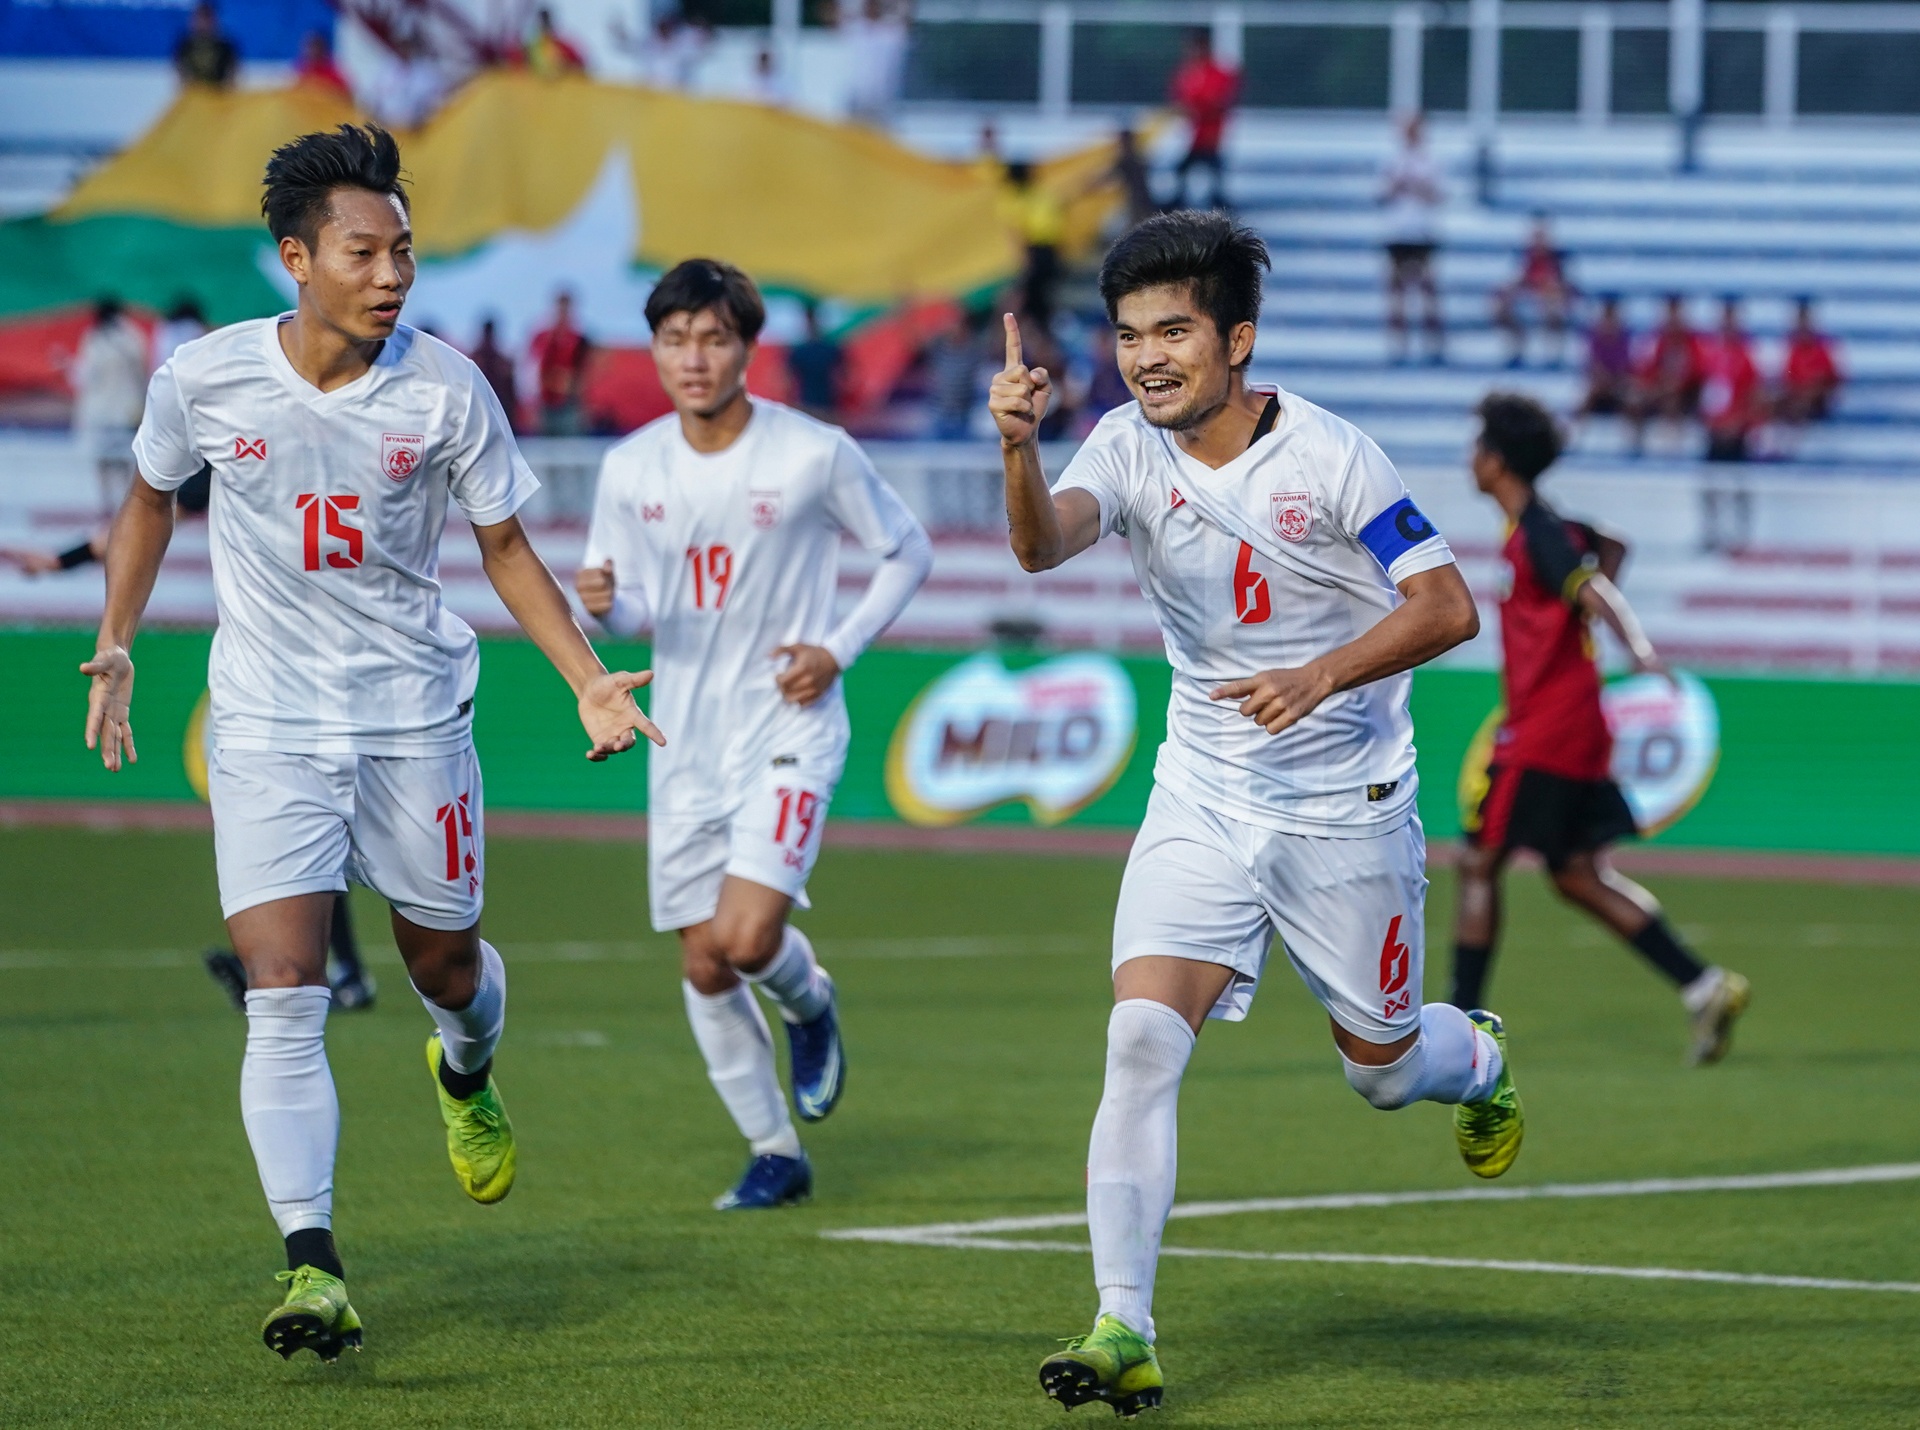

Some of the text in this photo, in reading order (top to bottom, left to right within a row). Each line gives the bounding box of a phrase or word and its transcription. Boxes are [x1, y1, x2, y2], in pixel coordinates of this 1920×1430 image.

[385, 436, 421, 444] MYANMAR
[1272, 494, 1307, 502] MYANMAR
[1395, 506, 1433, 542] C
[295, 493, 363, 571] 15
[686, 545, 732, 609] 19
[1233, 539, 1272, 624] 6
[775, 787, 817, 848] 19
[1380, 914, 1410, 995] 6
